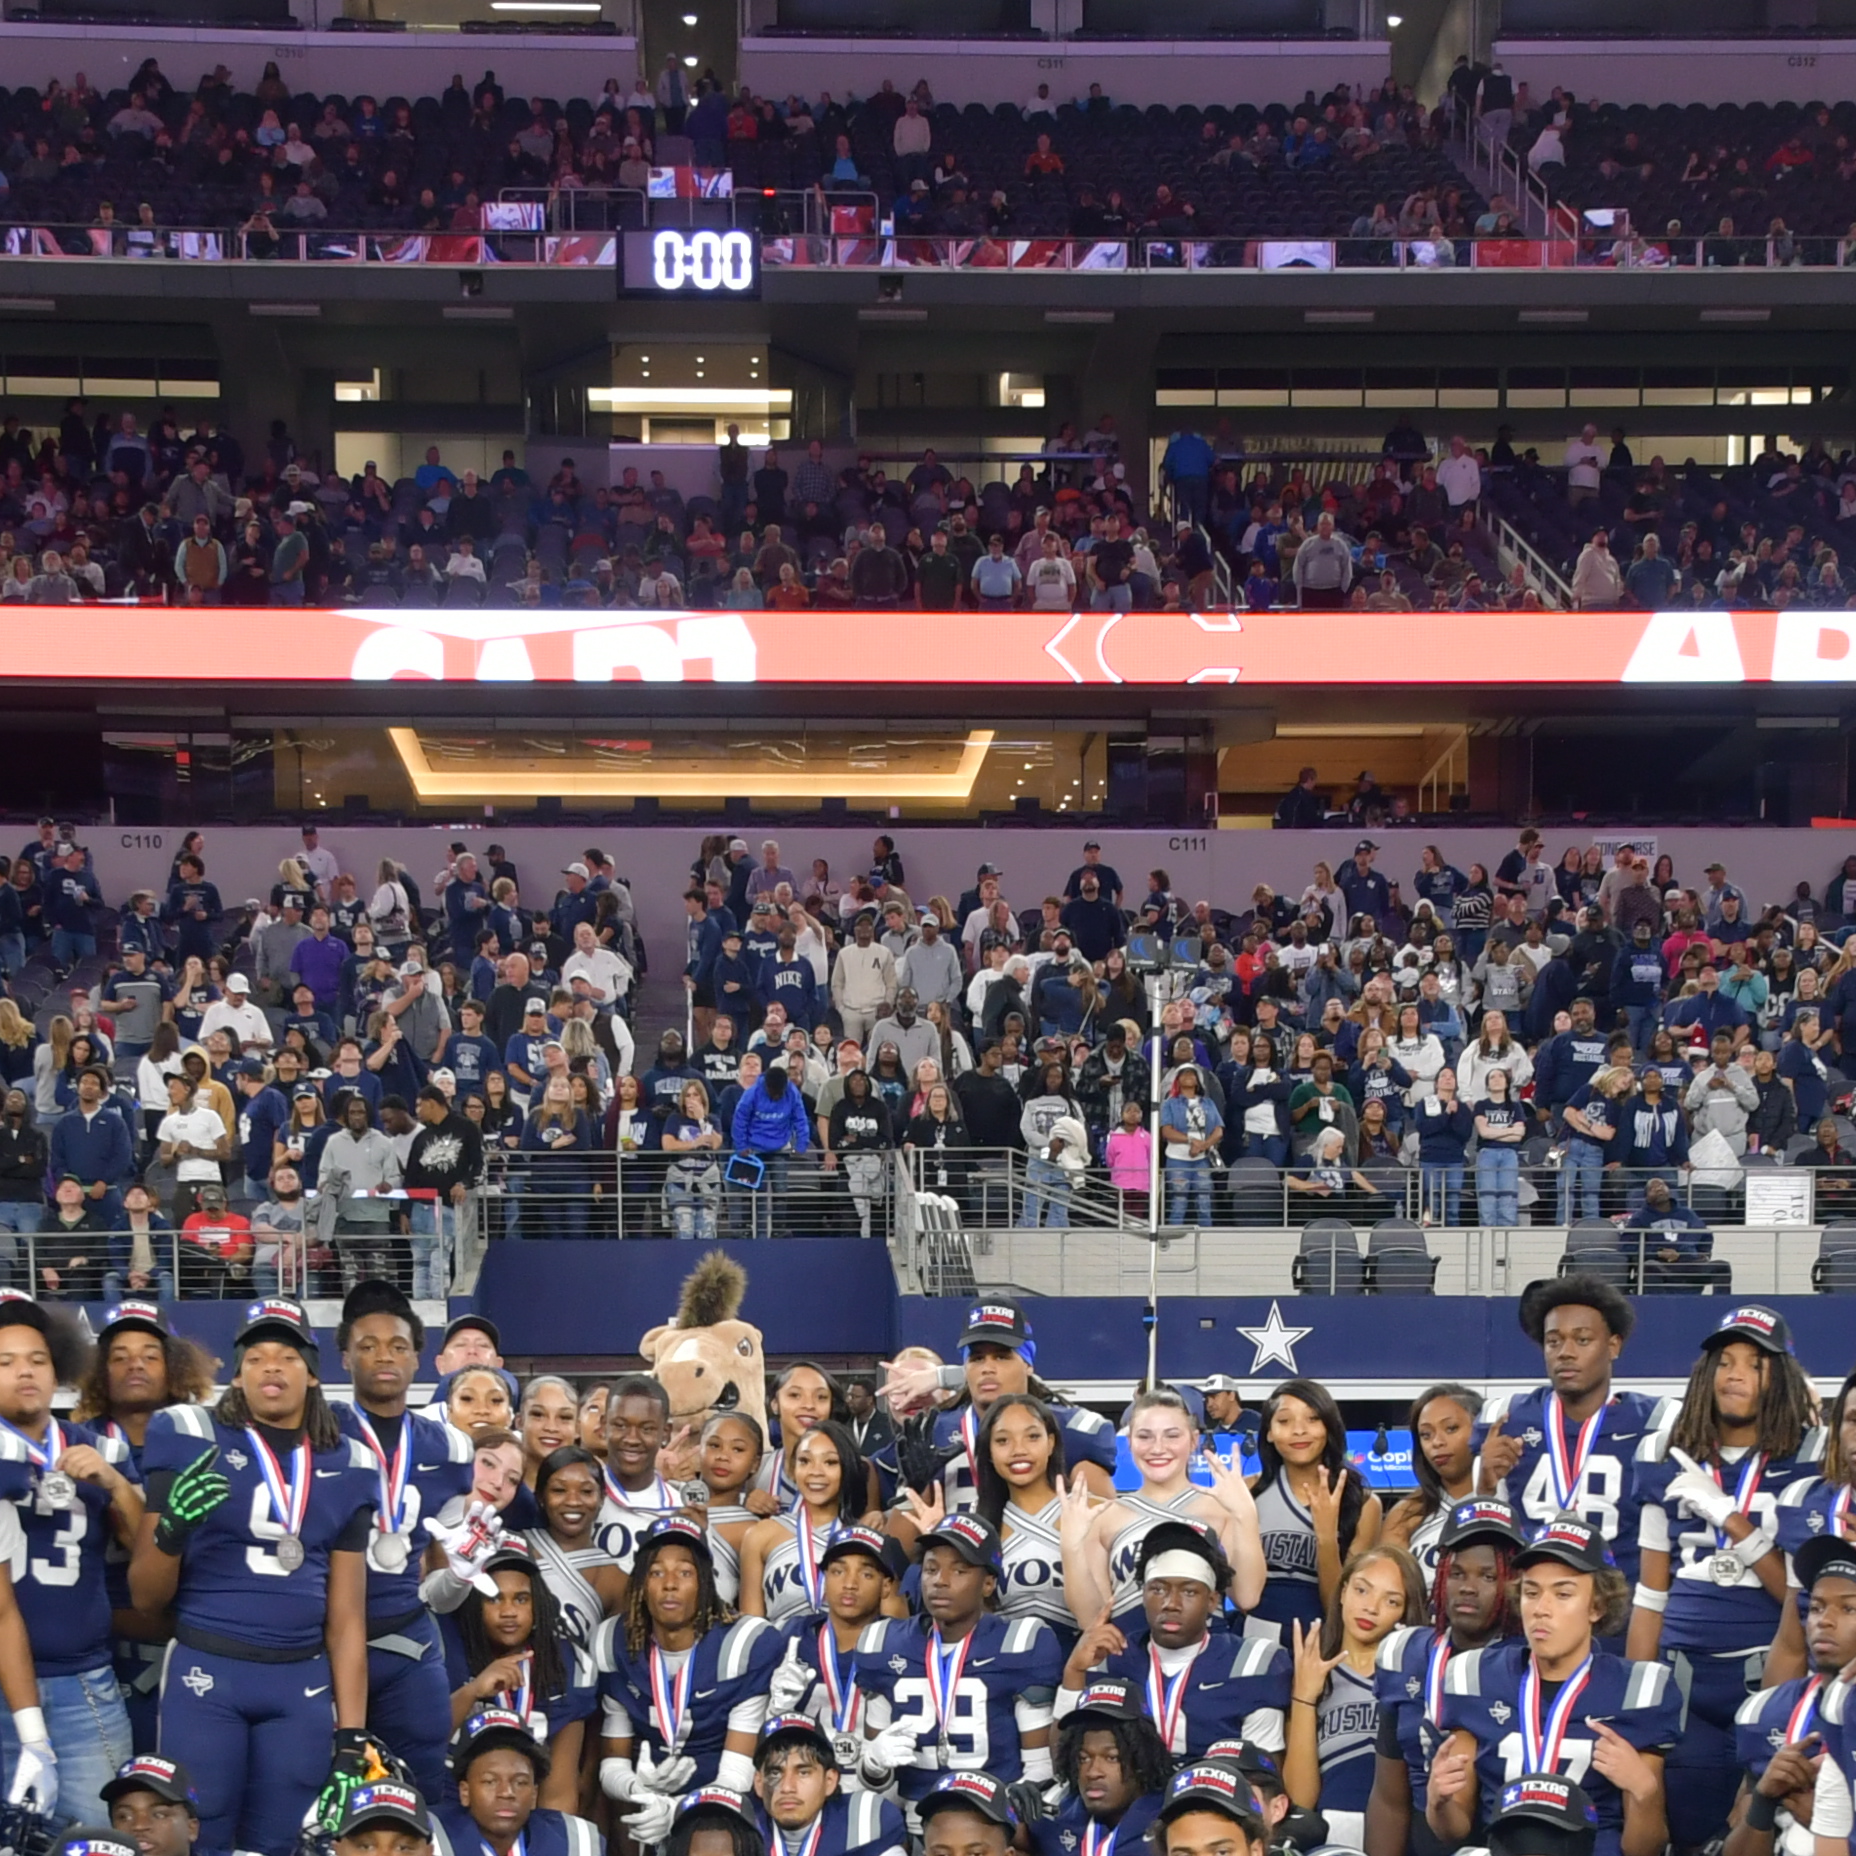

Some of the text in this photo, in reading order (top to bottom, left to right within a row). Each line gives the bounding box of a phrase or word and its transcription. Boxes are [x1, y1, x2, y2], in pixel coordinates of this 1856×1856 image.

[653, 231, 752, 290] 0:00
[120, 833, 163, 849] C110
[1168, 836, 1207, 852] C111
[774, 970, 803, 990] NIKE
[982, 1304, 1015, 1319] TEXAS
[1521, 1453, 1623, 1542] 48
[1472, 1501, 1512, 1519] TEXAS
[952, 1513, 989, 1542] TEXAS
[1548, 1521, 1592, 1543] TEXAS
[1089, 1684, 1126, 1699] TEXAS
[892, 1677, 989, 1771] 29
[953, 1771, 997, 1793] TEXAS
[1192, 1767, 1240, 1788] TEXAS
[372, 1785, 417, 1808] TEXAS
[699, 1786, 744, 1804] TEXAS
[1522, 1779, 1570, 1799] TEXAS
